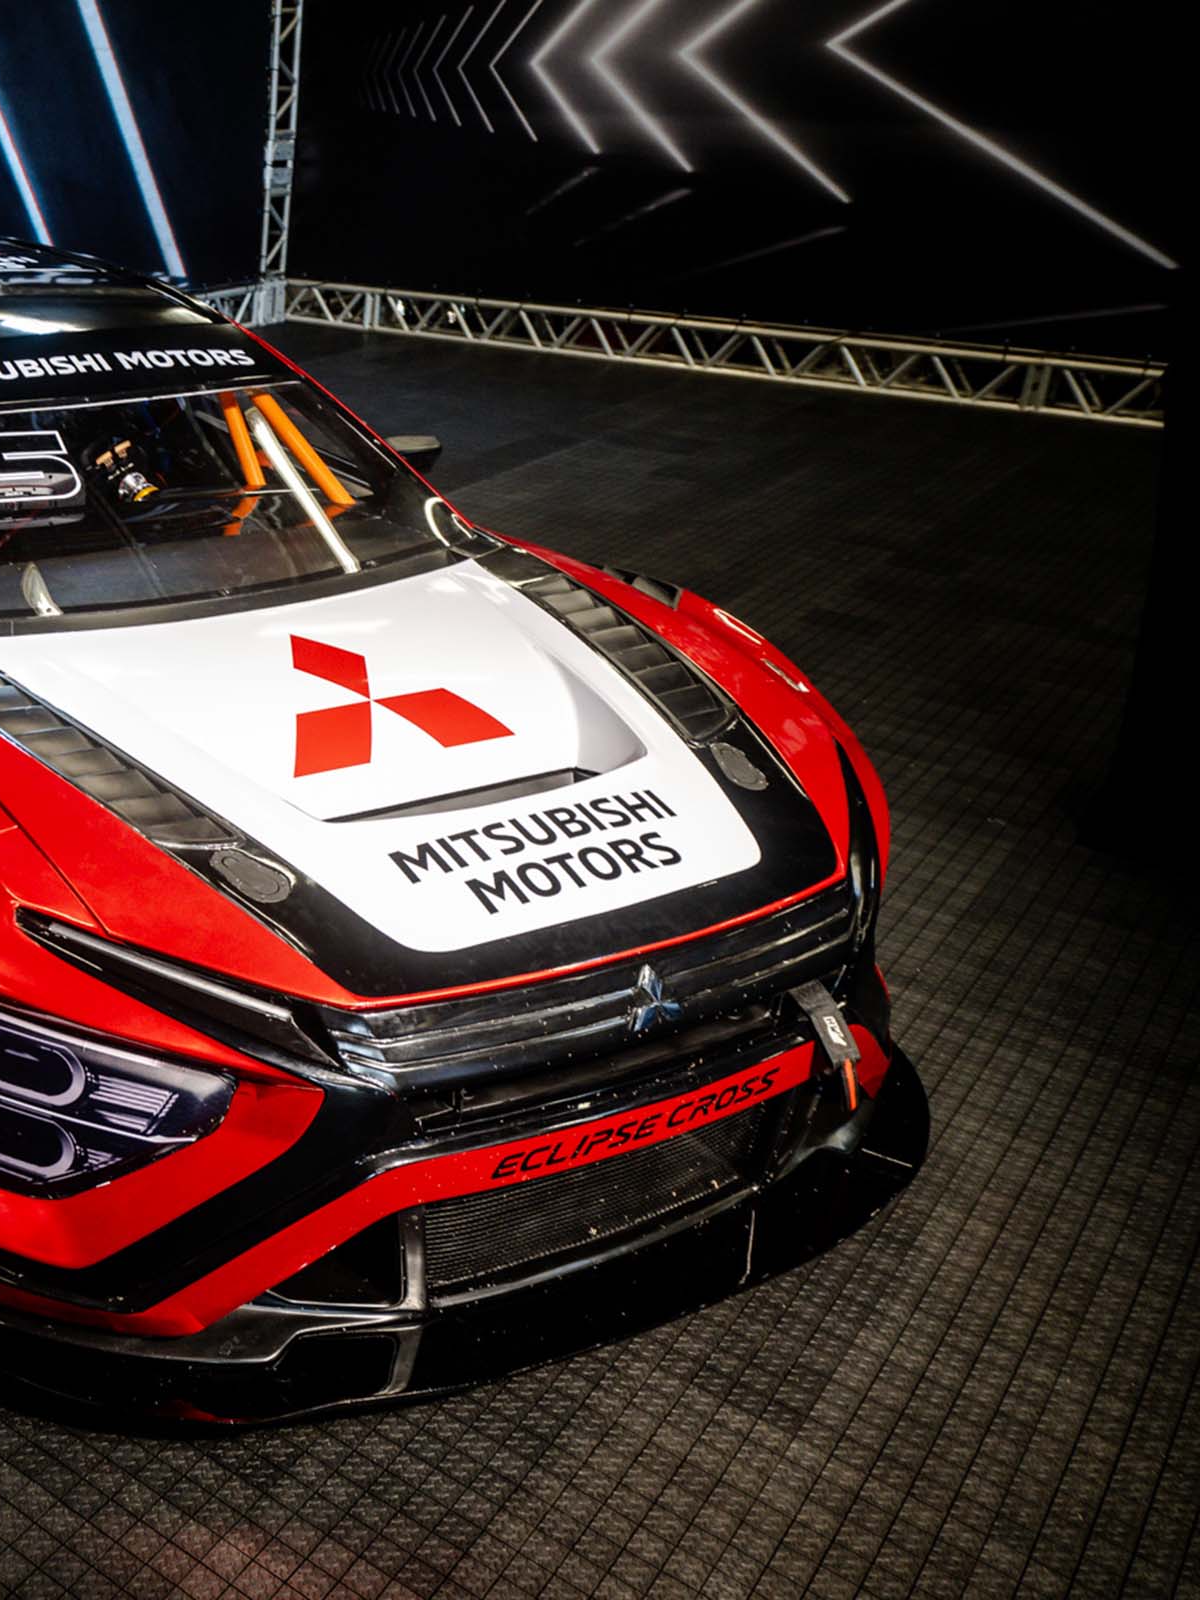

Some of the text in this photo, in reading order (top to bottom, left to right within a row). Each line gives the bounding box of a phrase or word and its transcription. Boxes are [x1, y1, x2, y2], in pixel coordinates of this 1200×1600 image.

[112, 349, 256, 371] MOTORS
[387, 789, 678, 884] MITSUBISHI
[464, 832, 682, 915] MOTORS
[491, 1067, 780, 1180] ECLIPSE CROSS
